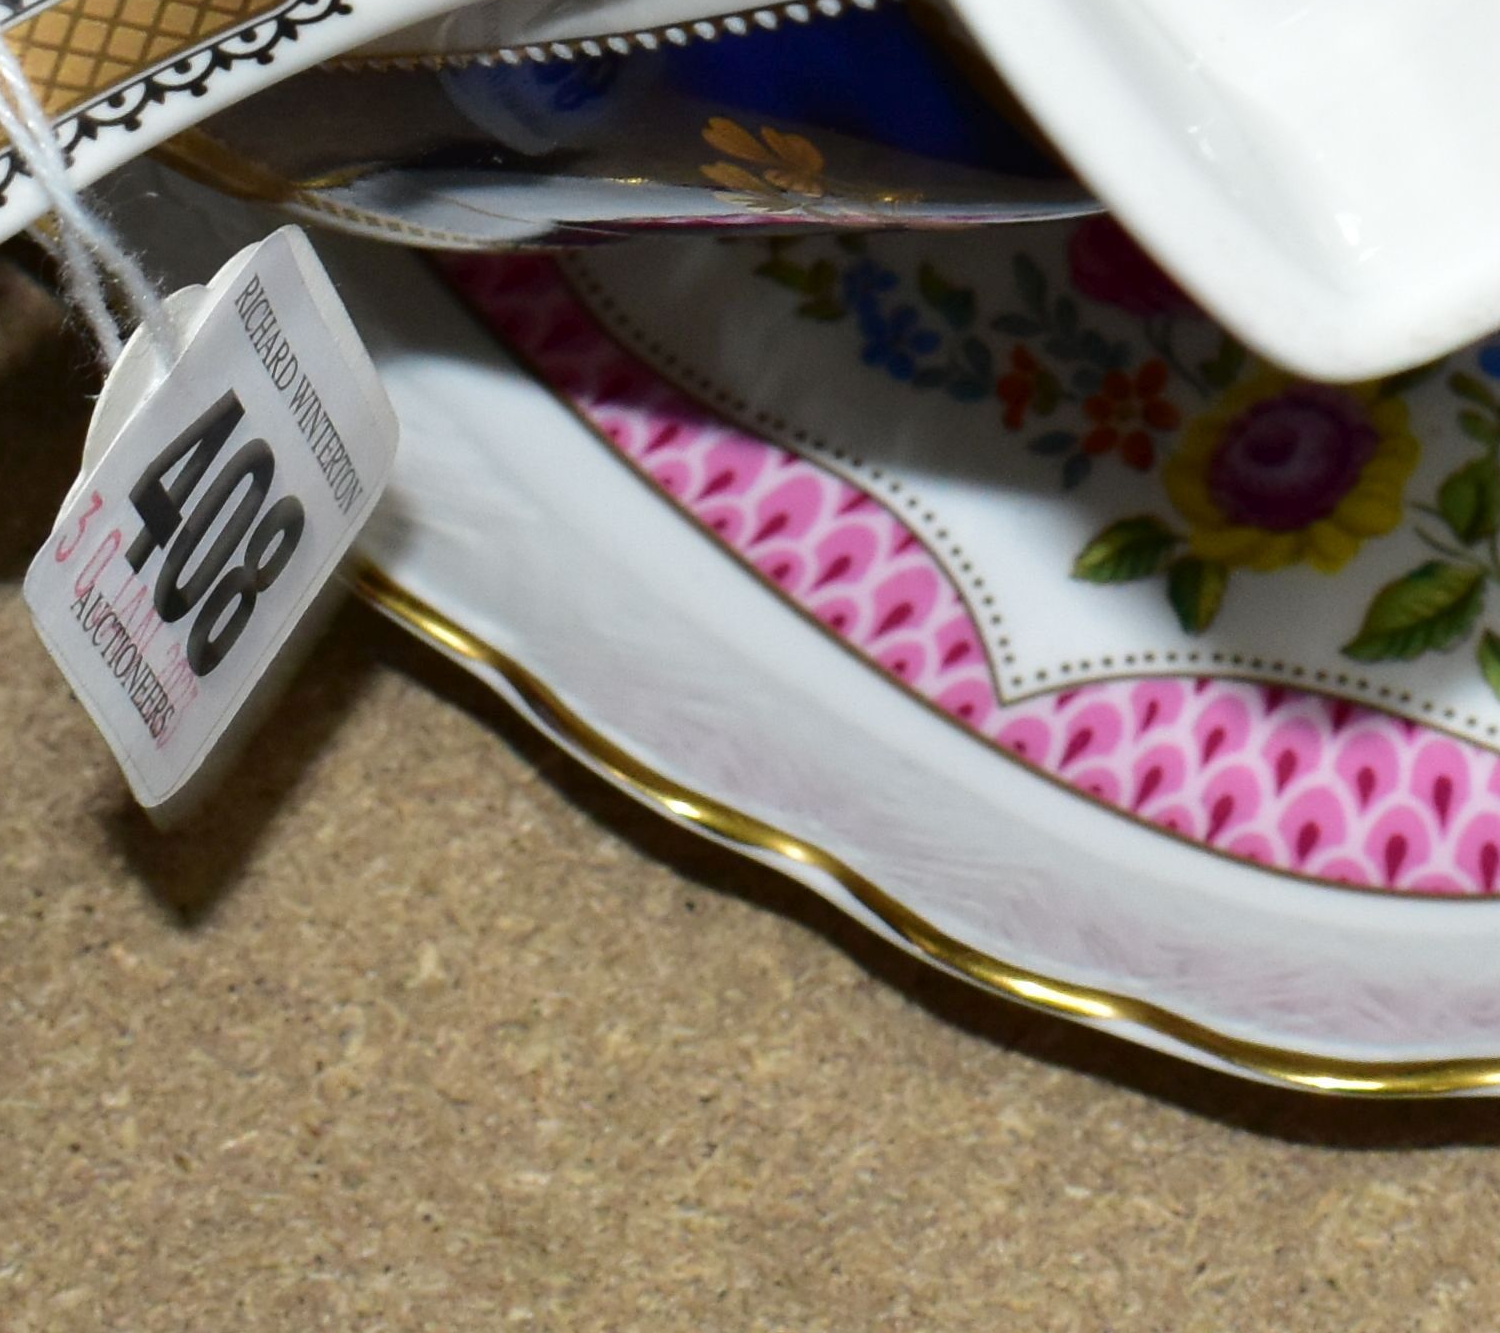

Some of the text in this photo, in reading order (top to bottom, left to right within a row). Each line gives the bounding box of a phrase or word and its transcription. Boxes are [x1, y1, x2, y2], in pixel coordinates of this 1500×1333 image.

[235, 273, 363, 515] RICHARD WINTERTON
[125, 388, 305, 677] 408
[70, 583, 176, 738] AUCTIONEERS
